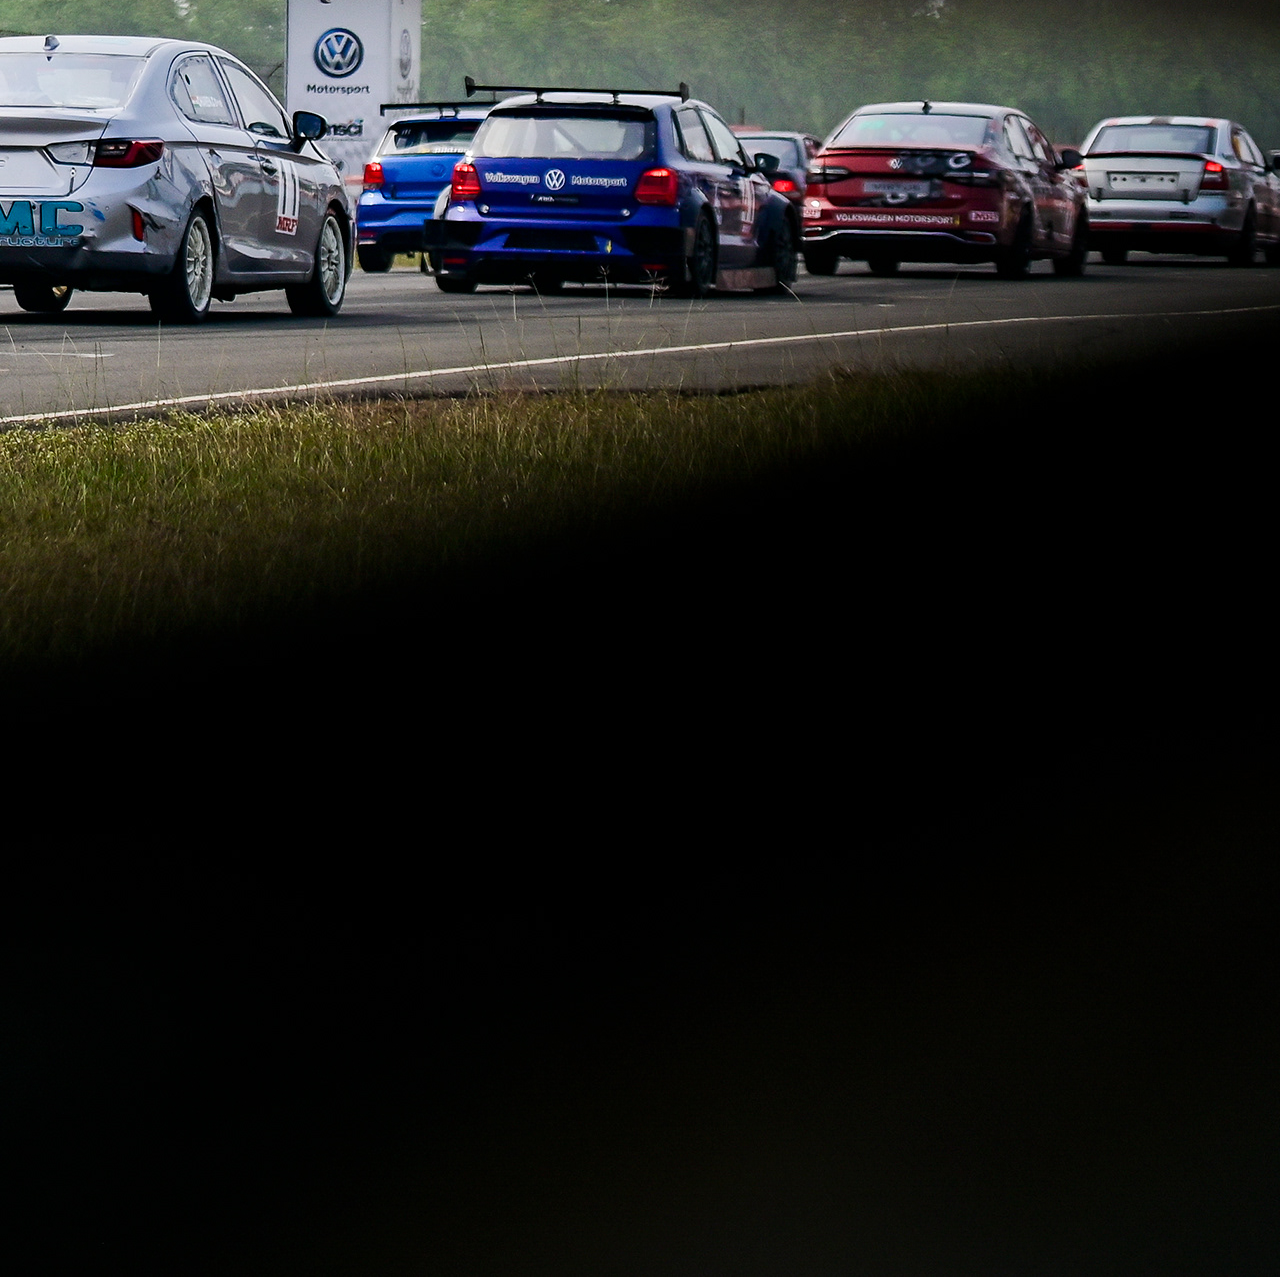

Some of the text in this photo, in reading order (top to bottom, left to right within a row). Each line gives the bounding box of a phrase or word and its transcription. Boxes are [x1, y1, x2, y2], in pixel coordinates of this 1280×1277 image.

[306, 84, 371, 95] Motorsport
[485, 172, 627, 187] Volkswagen Motorsport
[835, 214, 895, 222] VOLKSWAGEN
